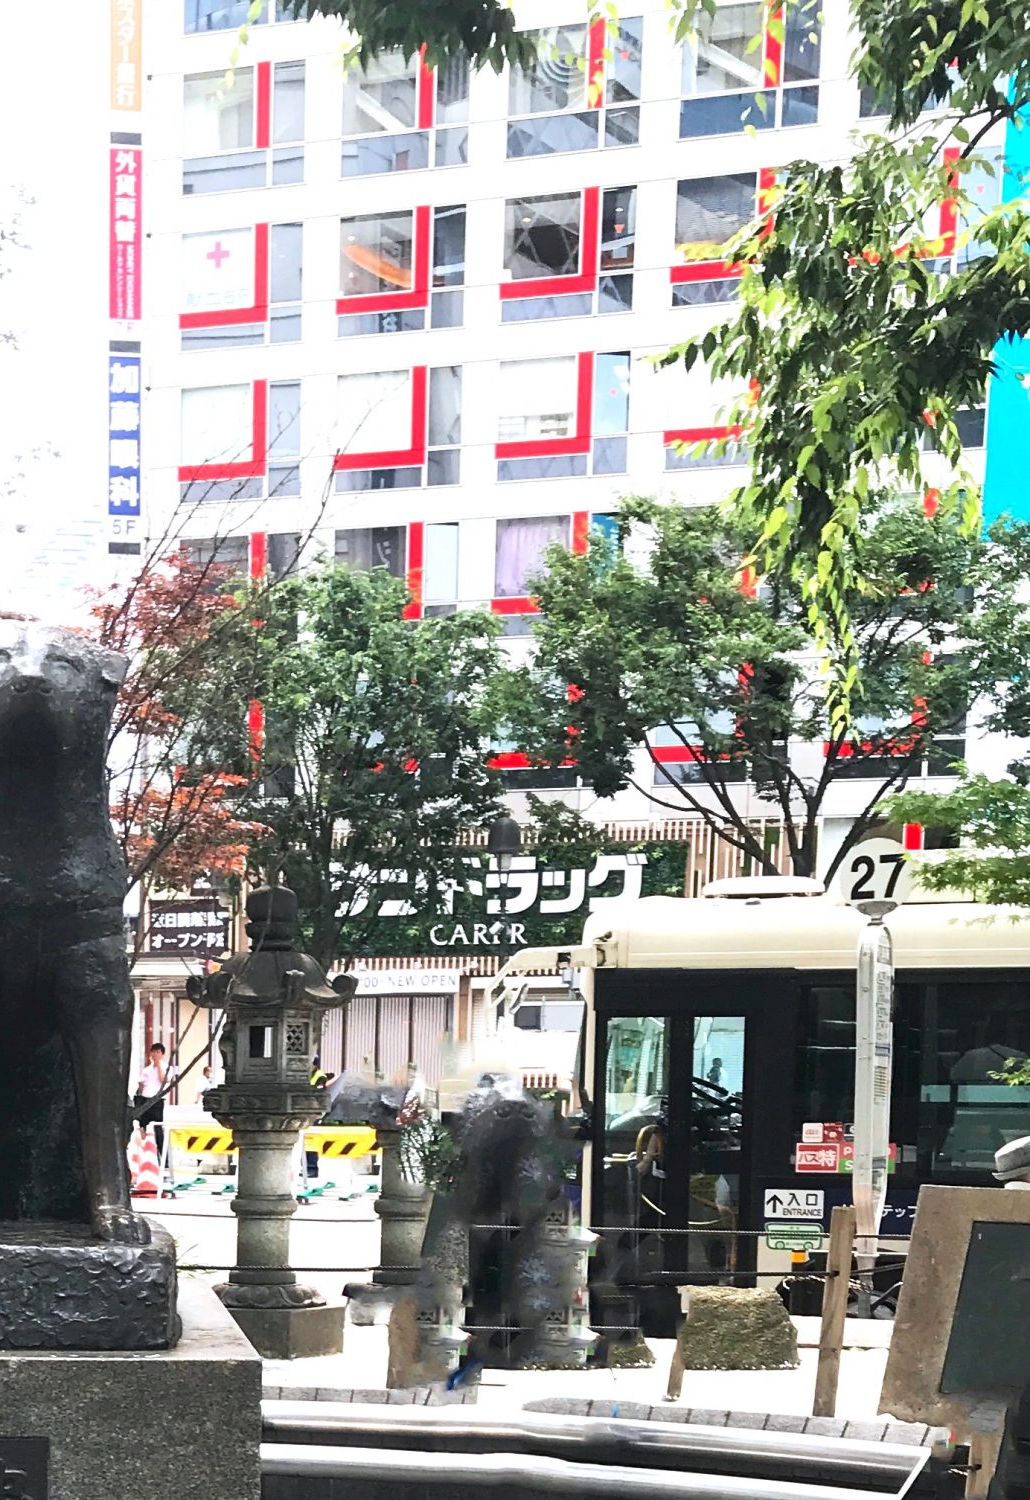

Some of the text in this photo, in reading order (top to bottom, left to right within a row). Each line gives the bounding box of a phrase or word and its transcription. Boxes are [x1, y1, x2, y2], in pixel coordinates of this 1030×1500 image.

[112, 519, 137, 535] 5F
[851, 853, 908, 900] 27
[421, 974, 457, 987] OPEN
[787, 1192, 819, 1207] 入口
[782, 1208, 822, 1217] ENTRANCE
